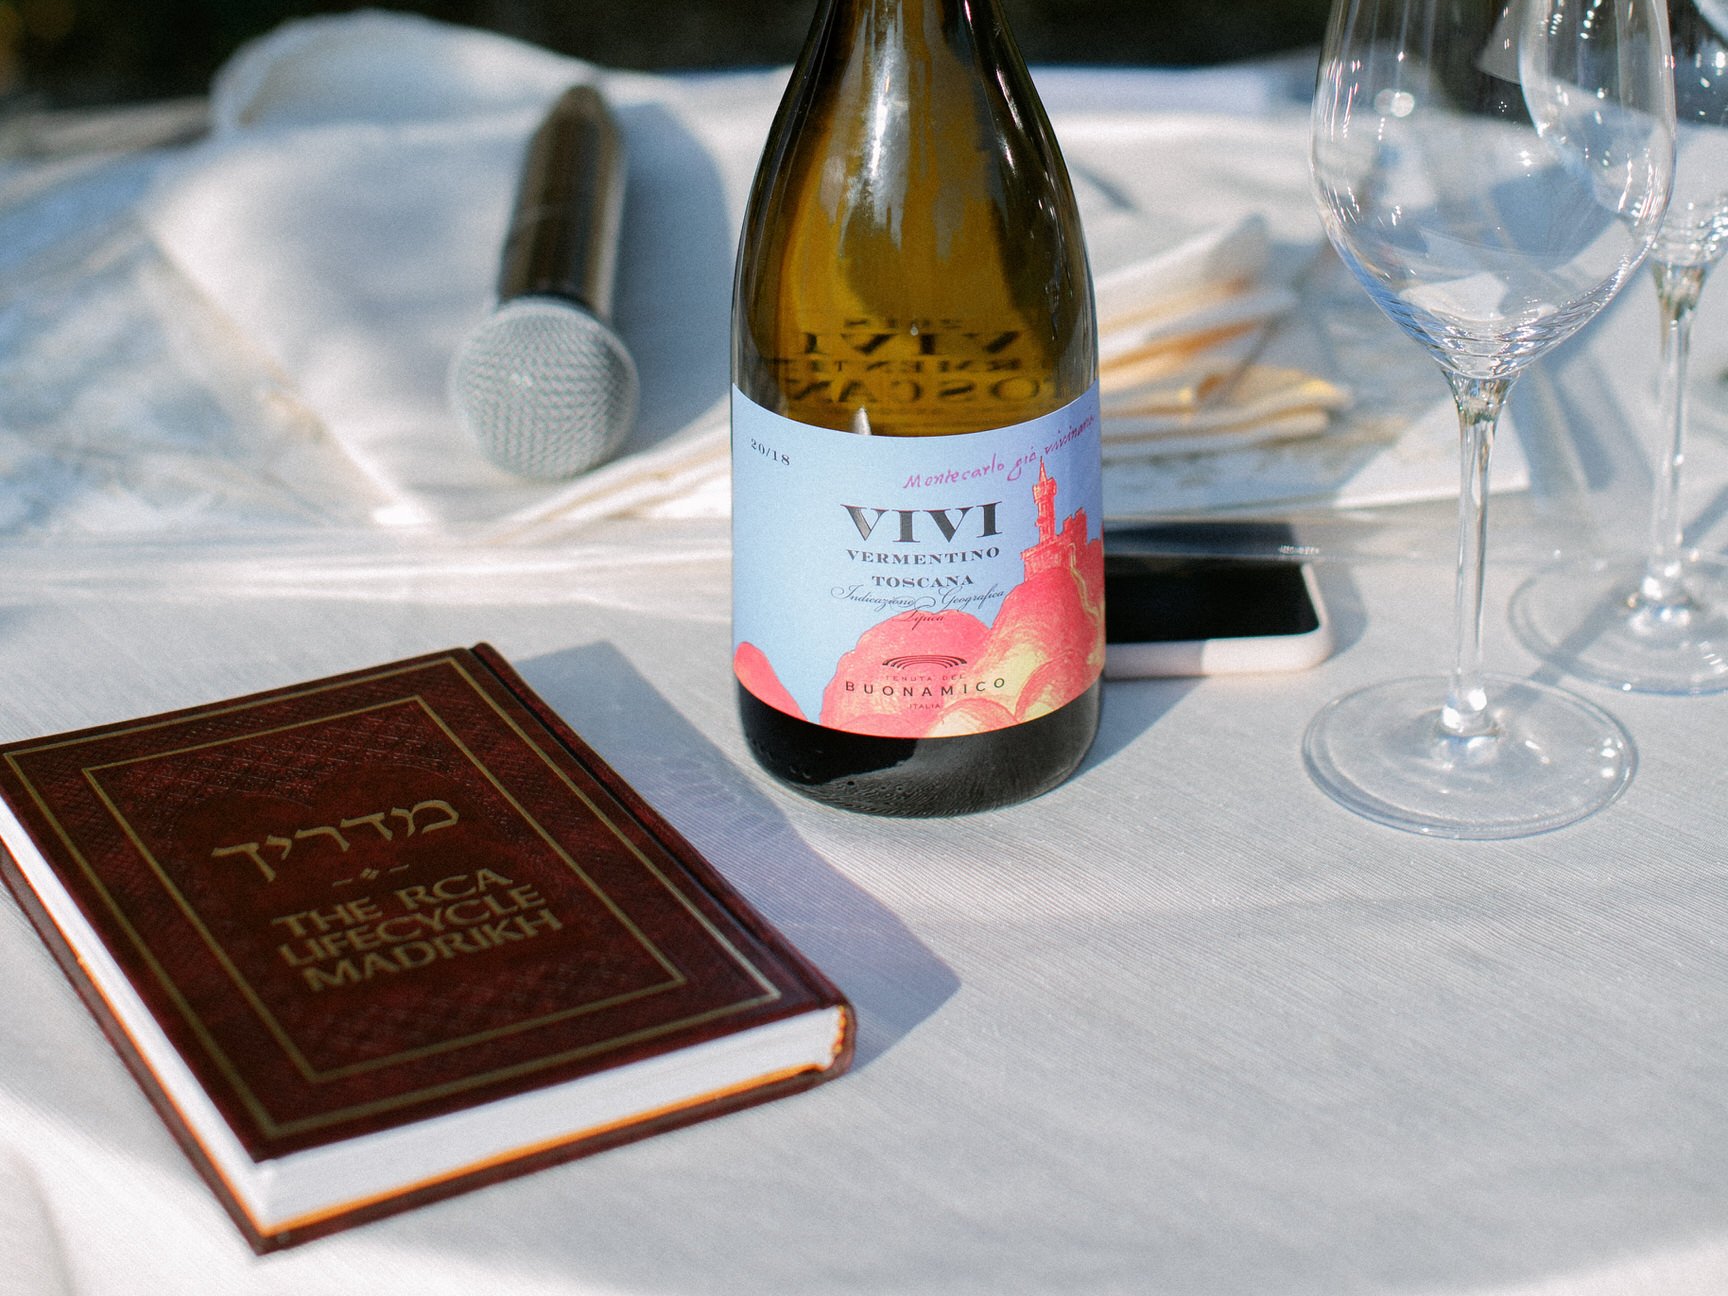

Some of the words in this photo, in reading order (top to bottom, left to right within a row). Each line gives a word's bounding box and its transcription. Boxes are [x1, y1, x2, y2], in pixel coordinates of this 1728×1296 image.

[750, 438, 790, 466] 20/18
[903, 452, 1005, 489] Montecarlo
[840, 501, 1003, 544] VIVI
[846, 546, 1000, 565] VERMENTINO
[830, 584, 915, 612] Indicazione
[938, 584, 1006, 612] Geografica
[871, 574, 974, 588] TOSCANA
[845, 677, 1005, 697] BUONAMICO
[211, 799, 460, 882] מדריך
[271, 897, 383, 940] THE
[395, 867, 514, 910] RCA
[278, 883, 547, 967] LIFECYCLE
[302, 907, 564, 992] MADRIKH
